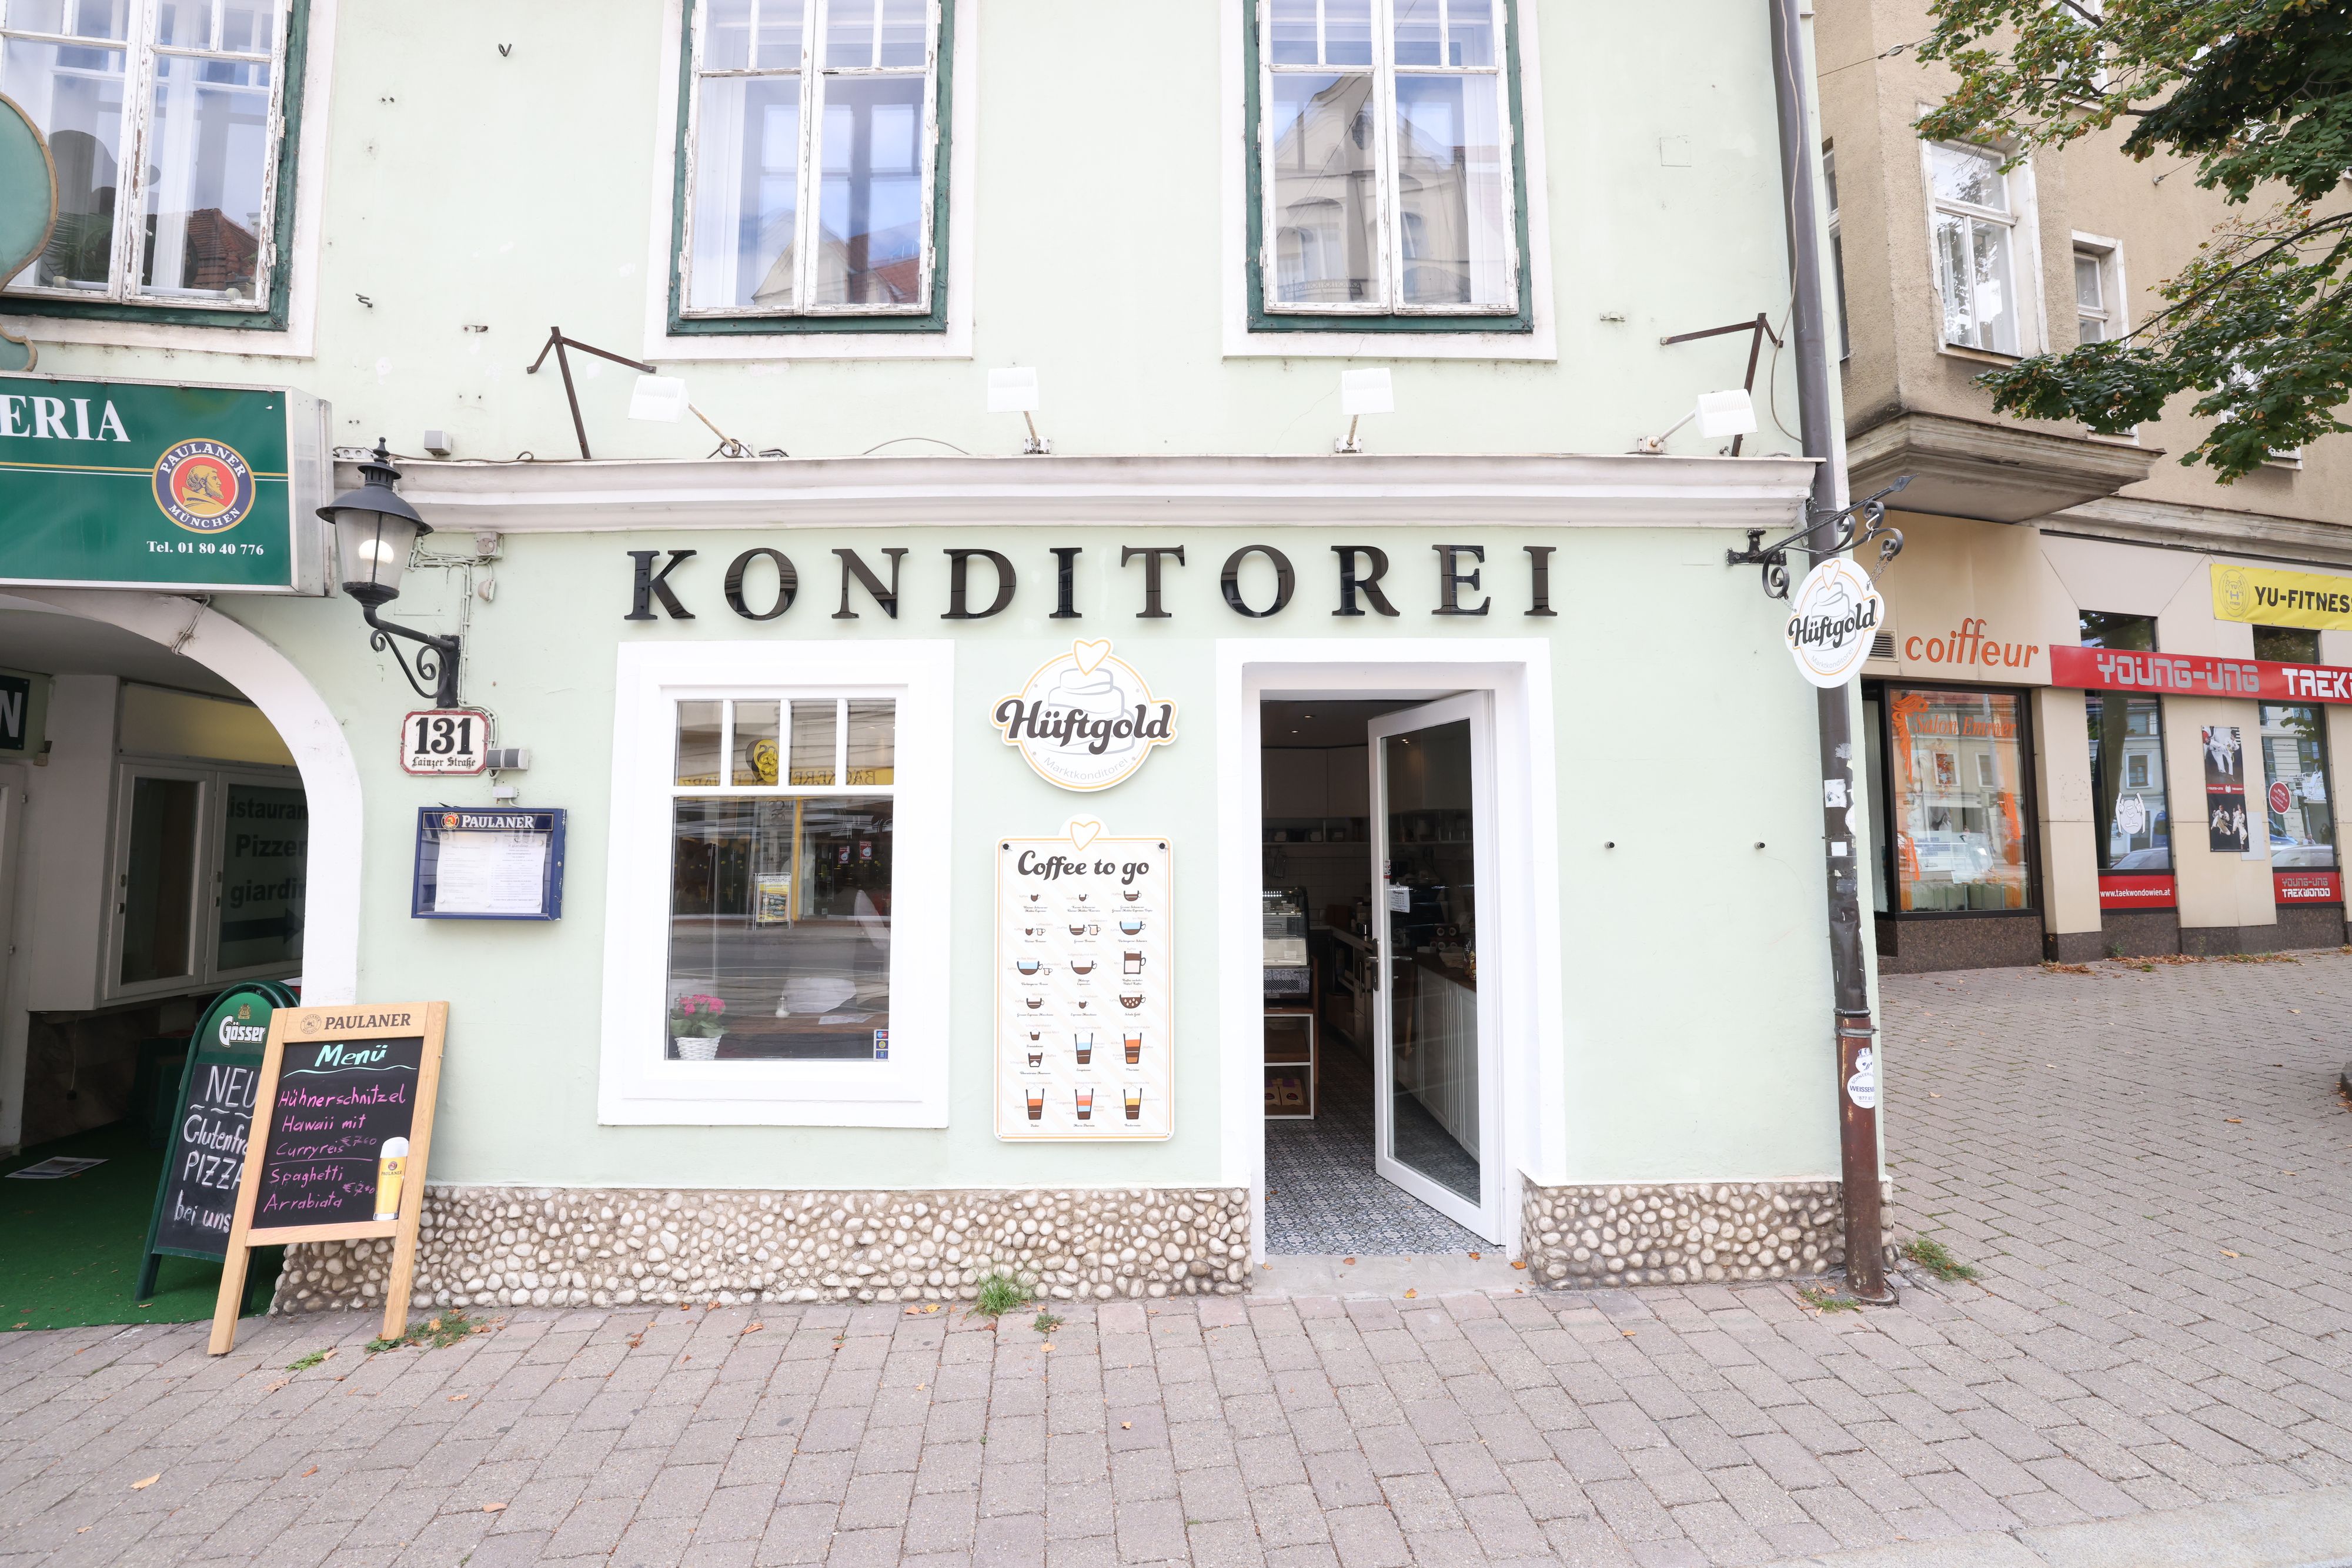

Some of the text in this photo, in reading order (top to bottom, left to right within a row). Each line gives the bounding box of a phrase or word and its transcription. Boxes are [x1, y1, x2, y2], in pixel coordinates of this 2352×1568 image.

[0, 394, 131, 442] ERIA
[160, 443, 246, 477] PAULANER
[168, 504, 240, 527] MÜNCHEN
[146, 541, 264, 556] Tel. 01 80 40 776
[624, 544, 1558, 621] KONDITOREI
[2254, 586, 2352, 613] YU-FITNES
[1788, 599, 1877, 648] Hüftgold
[1905, 617, 2039, 668] coiffeur
[1811, 648, 1854, 668] Marktkonditorei
[2097, 653, 2352, 698] YOUNG-UNG TAEK
[415, 717, 473, 754] 131
[996, 700, 1172, 755] Hüftgold
[1915, 713, 2018, 738] Salon Emmer
[412, 757, 476, 770] Lainzer Straße
[1043, 756, 1128, 780] Marktkonditorei
[226, 796, 308, 819] istauran
[461, 815, 534, 829] PAULANER
[1018, 850, 1149, 885] Coffee to go
[2100, 888, 2171, 898] www.taekwondowien.at
[2282, 877, 2328, 887] YOUNG-UNG
[2282, 888, 2330, 898] TAEKWONDO
[218, 1015, 266, 1047] Gösser
[324, 1014, 411, 1029] PAULANER
[315, 1044, 388, 1066] Menü
[205, 1066, 260, 1108] NEU
[278, 1084, 406, 1108] Hühnerschnitzel
[282, 1114, 366, 1132] Hawaii mit
[276, 1140, 344, 1159] Curryreis
[270, 1165, 343, 1188] Spaghetti
[174, 1189, 232, 1233] bei uns
[263, 1191, 343, 1213] Arrabiata
